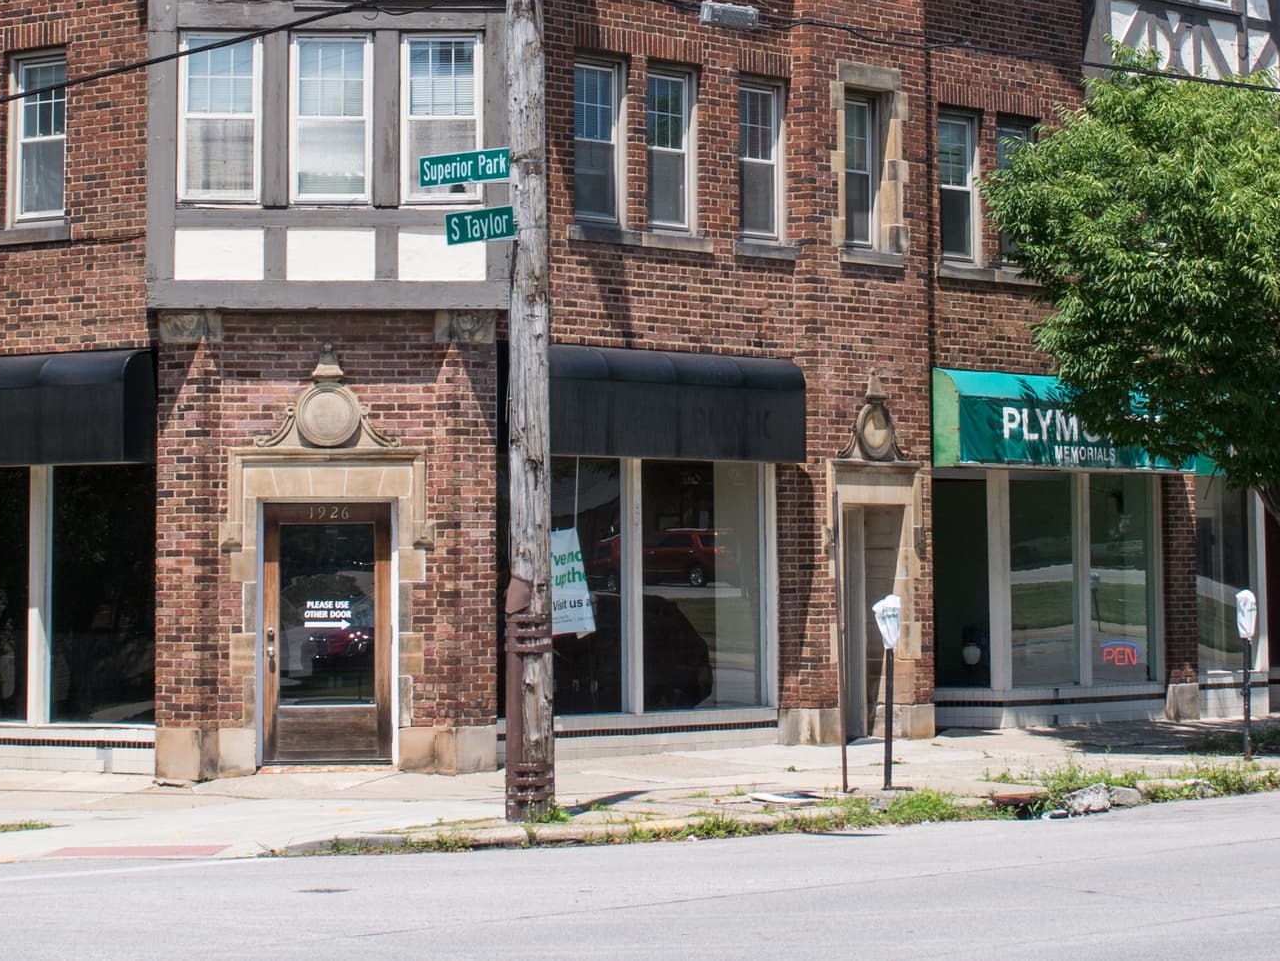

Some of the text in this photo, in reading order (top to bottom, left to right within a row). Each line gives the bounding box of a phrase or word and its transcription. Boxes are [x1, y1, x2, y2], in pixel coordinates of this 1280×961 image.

[423, 153, 506, 184] Superior Park
[451, 213, 508, 241] S Taylor
[1002, 406, 1115, 443] PLYM
[1054, 445, 1116, 465] MEMORIALS
[309, 506, 350, 519] 1926
[306, 601, 350, 609] PLEASE USE
[569, 598, 584, 608] us
[304, 610, 351, 618] OTHER DOOR
[1103, 646, 1137, 666] PEN
